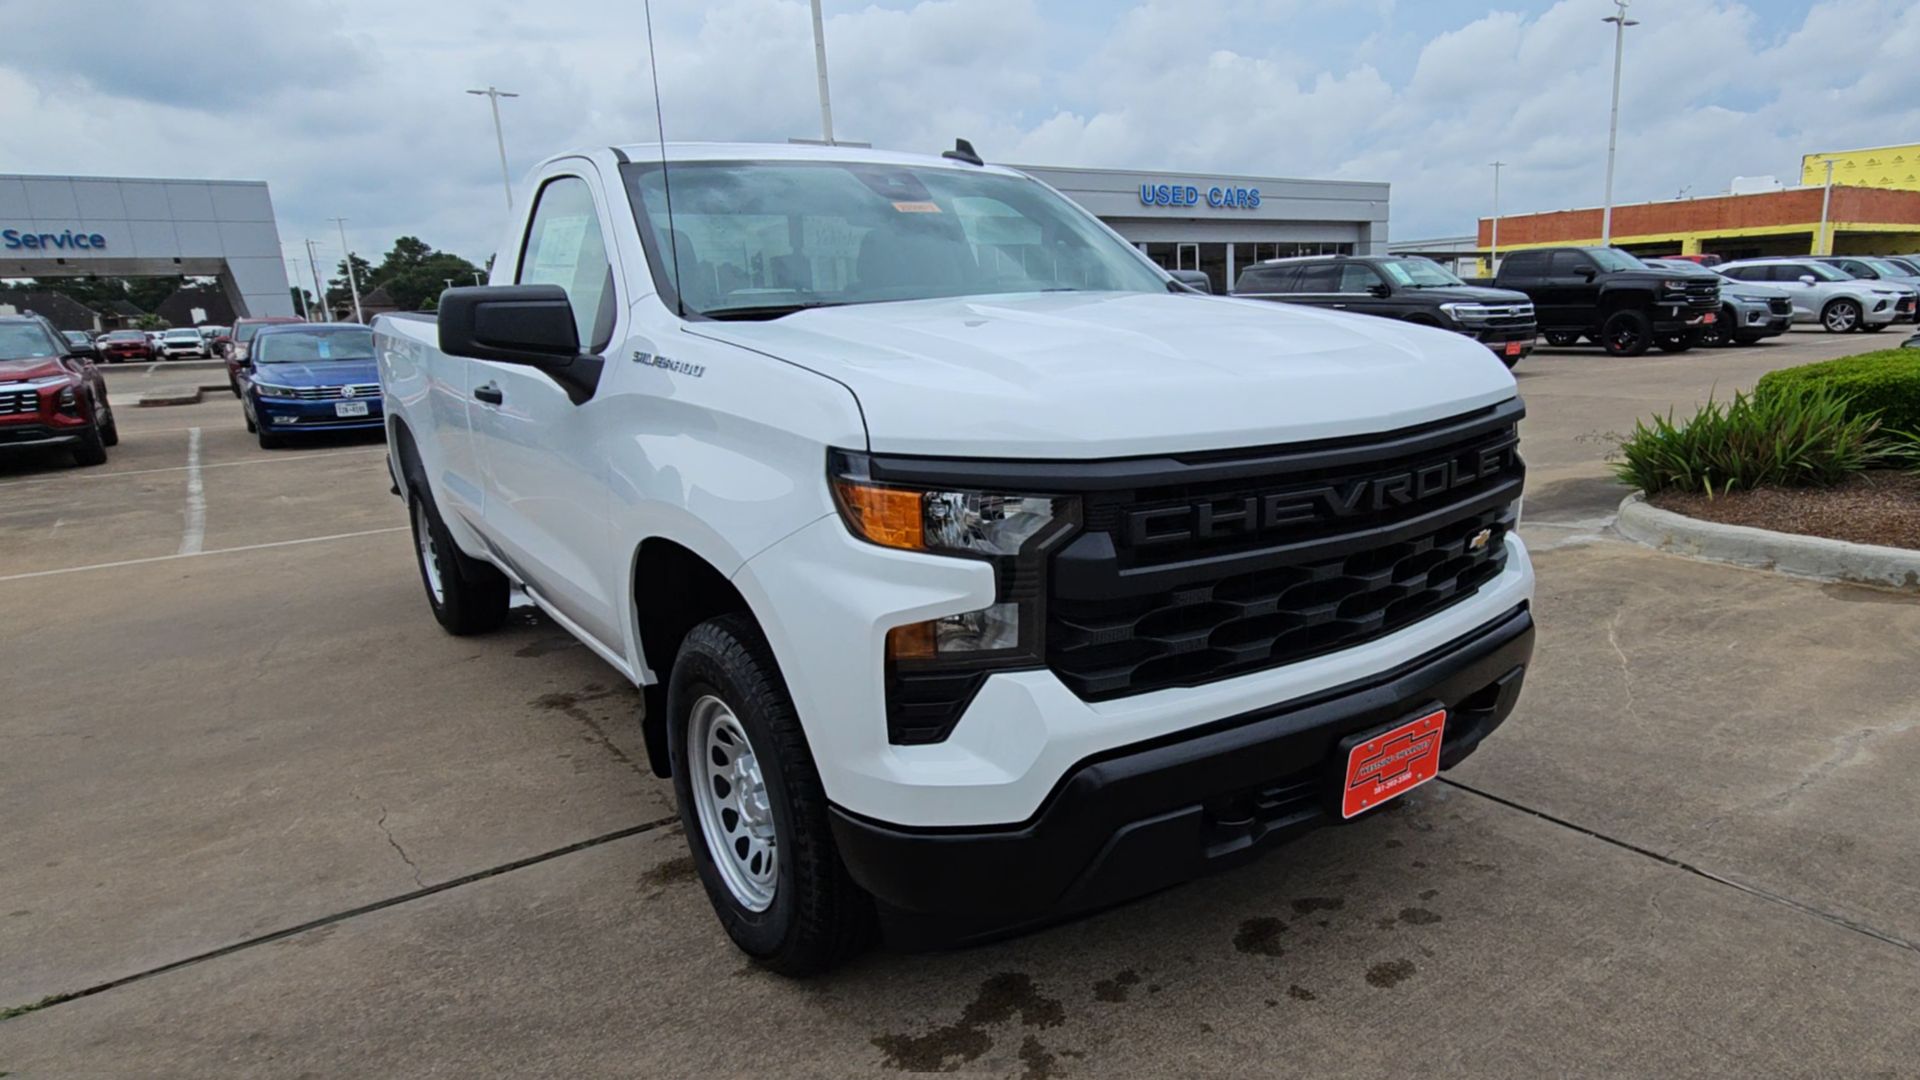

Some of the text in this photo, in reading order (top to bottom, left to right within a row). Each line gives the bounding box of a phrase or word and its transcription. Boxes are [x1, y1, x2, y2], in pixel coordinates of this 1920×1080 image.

[1140, 184, 1261, 208] USED CARS
[2, 229, 106, 249] Service
